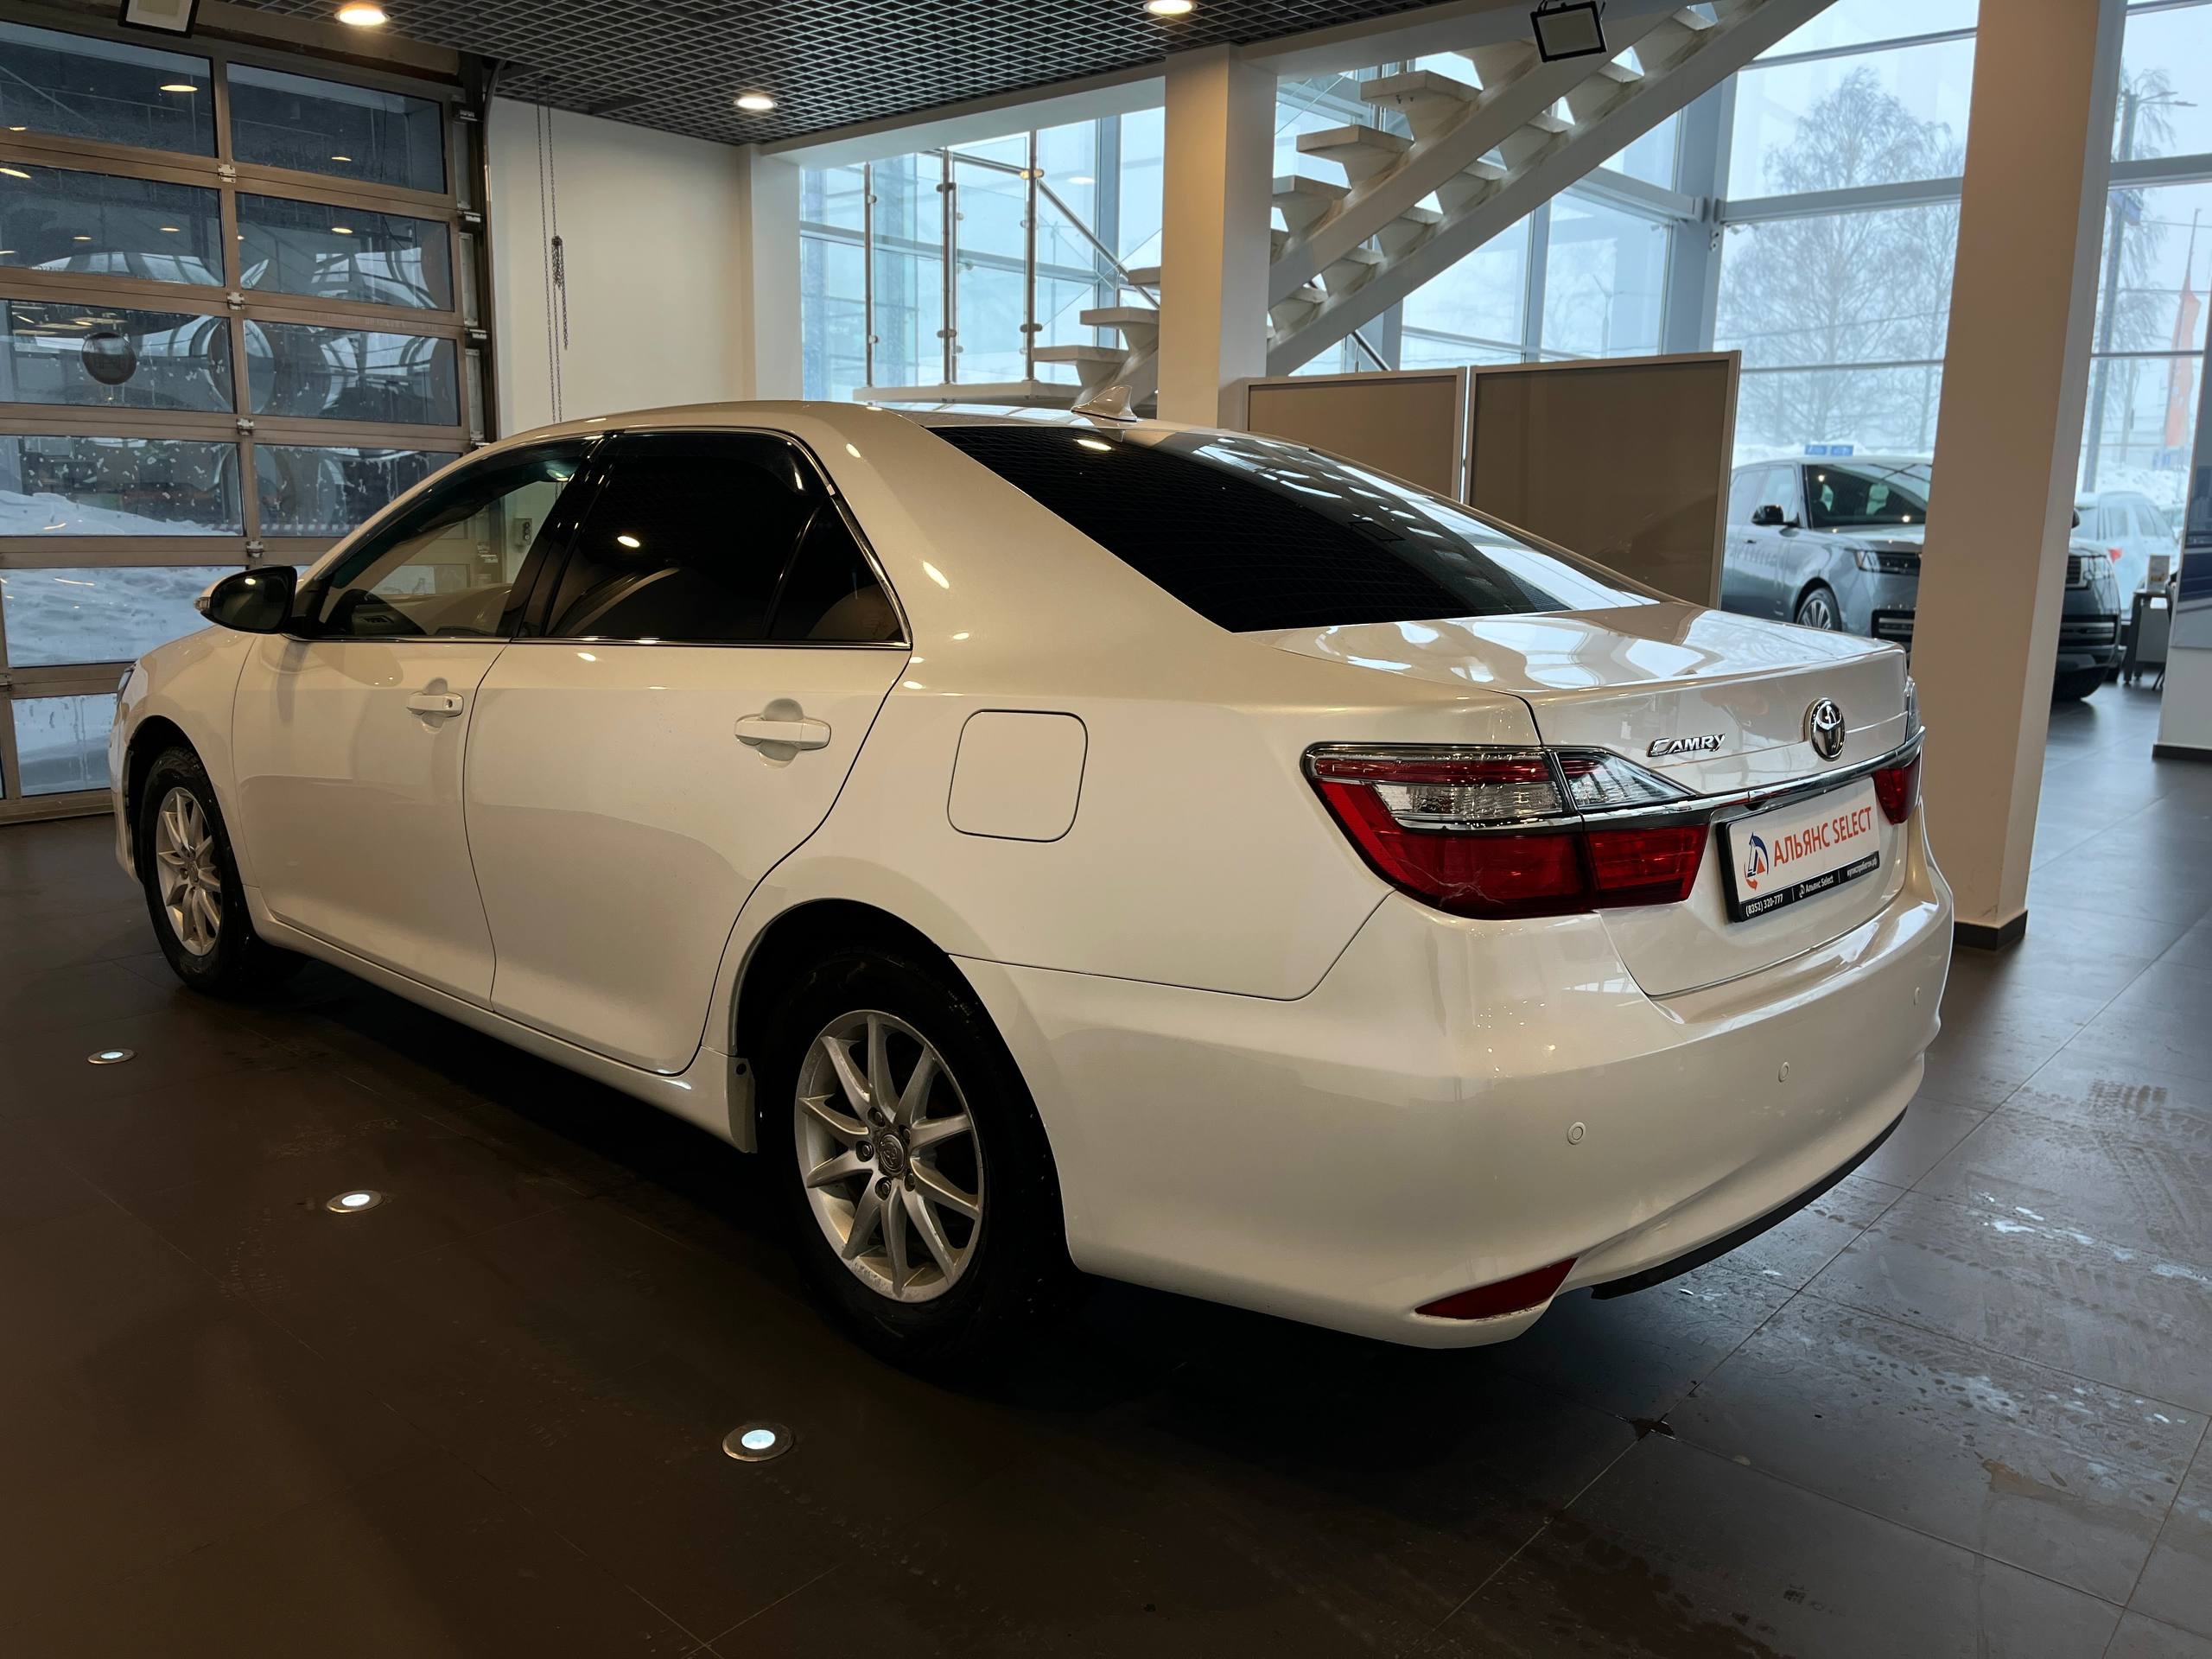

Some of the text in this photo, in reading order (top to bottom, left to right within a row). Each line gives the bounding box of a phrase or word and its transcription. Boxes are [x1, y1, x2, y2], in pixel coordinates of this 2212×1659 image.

[1647, 734, 1726, 757] CAMRY
[1773, 806, 1872, 867] АЛЬЯНС SELECT
[1745, 899, 1764, 917] (8352)
[1764, 893, 1783, 909] 320-777
[1821, 875, 1834, 887] Select
